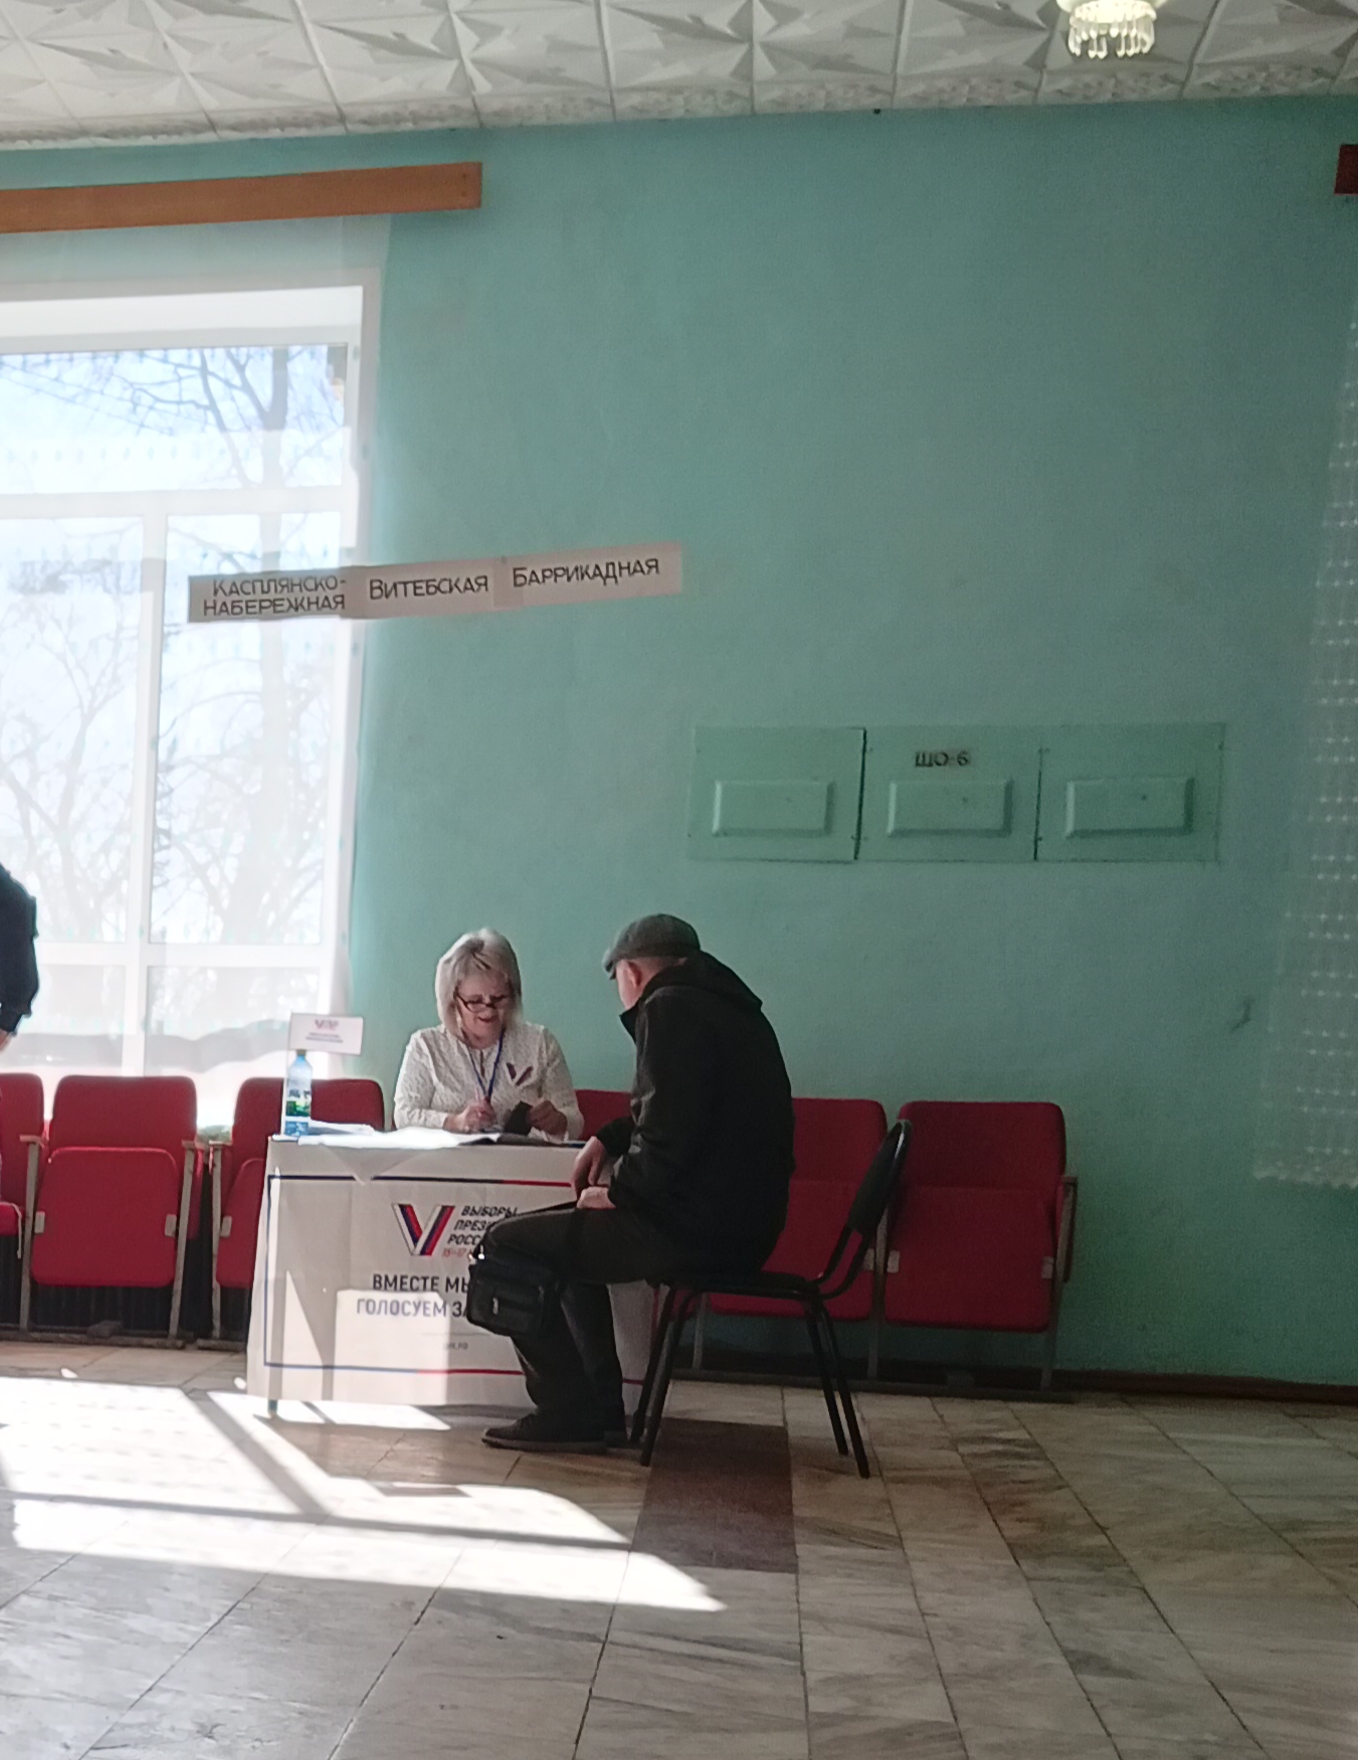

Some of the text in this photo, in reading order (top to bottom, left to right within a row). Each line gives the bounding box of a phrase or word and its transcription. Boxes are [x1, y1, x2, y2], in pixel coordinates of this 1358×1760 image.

[513, 558, 659, 587] БАРРИКАДНАЯ
[213, 575, 347, 597] КАСПЛЯНСКО-
[370, 575, 488, 600] ВИТЕБСКАЯ
[204, 594, 346, 616] НАБЕРЕЖНАЯ
[453, 1219, 490, 1231] ПРЕЗ
[447, 1234, 481, 1245] РОСС
[372, 1274, 440, 1292] ВМЕСТЕ
[356, 1298, 447, 1317] ГОЛОСУЕМ
